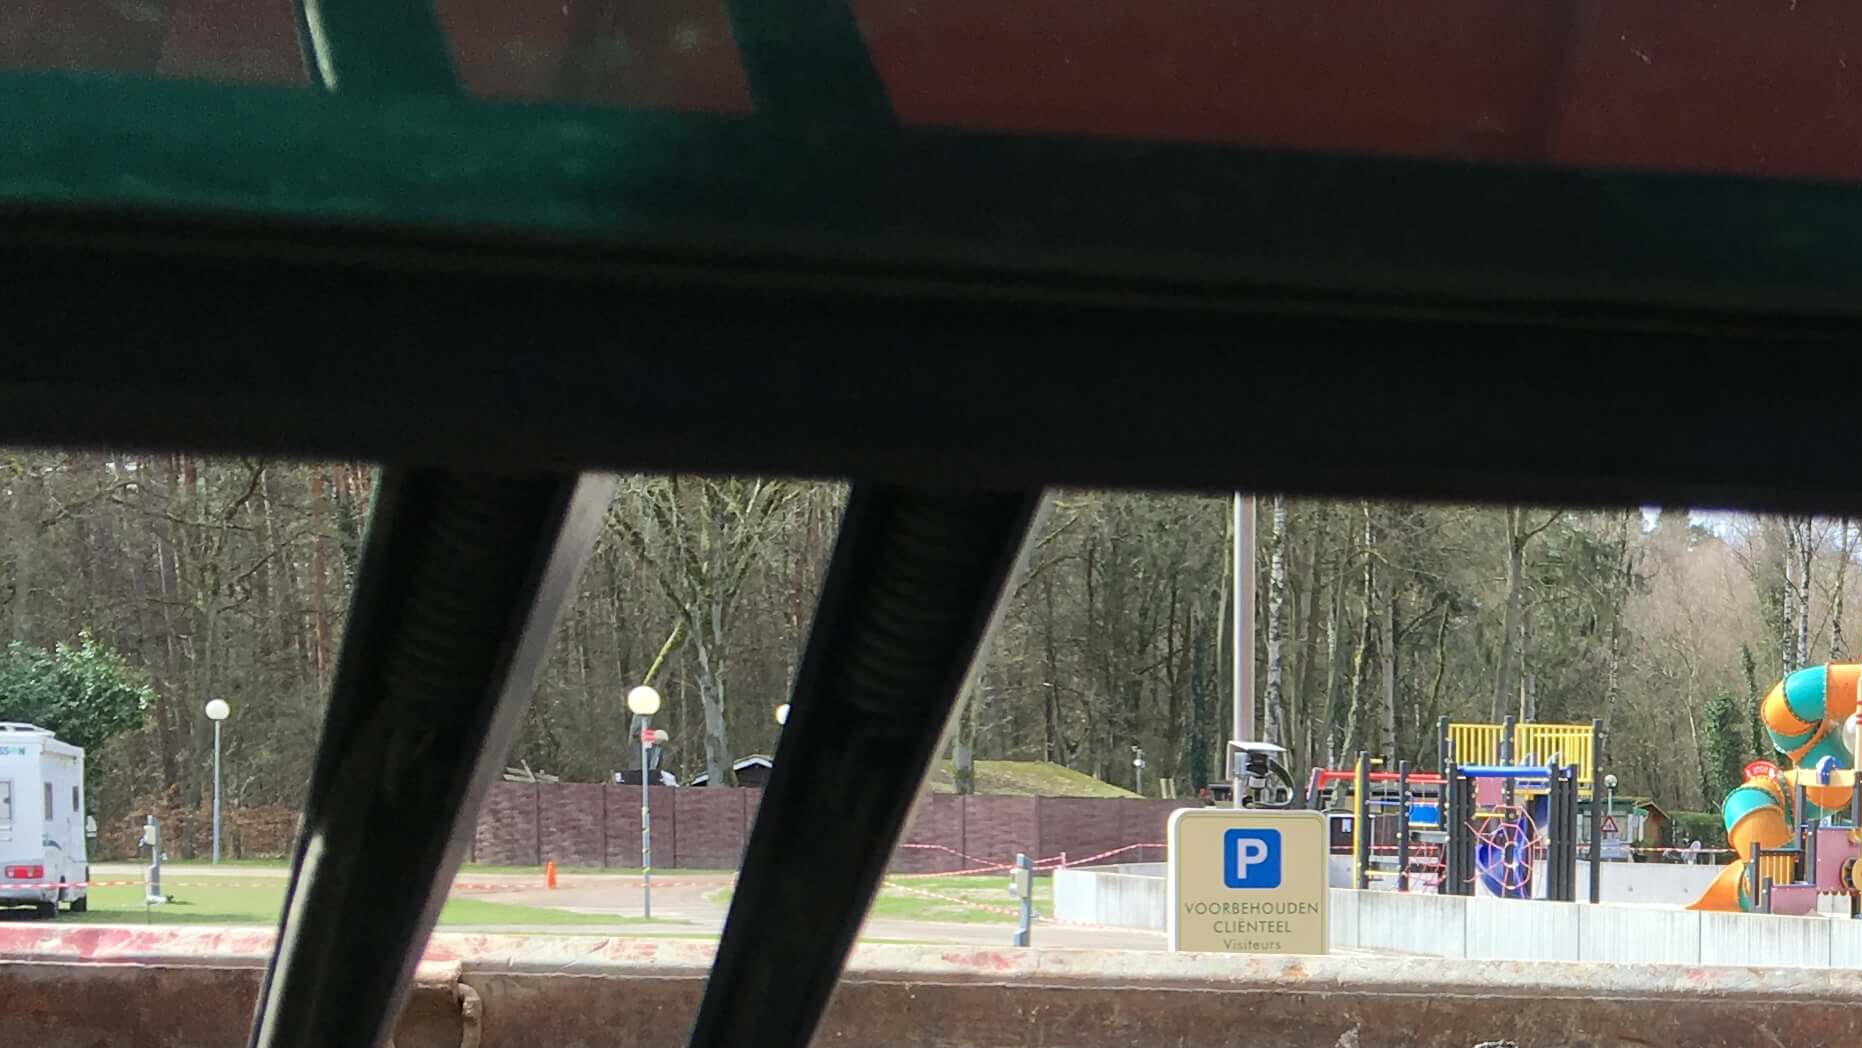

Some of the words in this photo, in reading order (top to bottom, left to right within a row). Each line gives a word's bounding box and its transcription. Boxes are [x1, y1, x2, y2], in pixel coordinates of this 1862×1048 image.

[1238, 838, 1268, 879] P
[1185, 902, 1319, 915] VOORBEHOUDEN
[1223, 939, 1281, 950] Visiteurs
